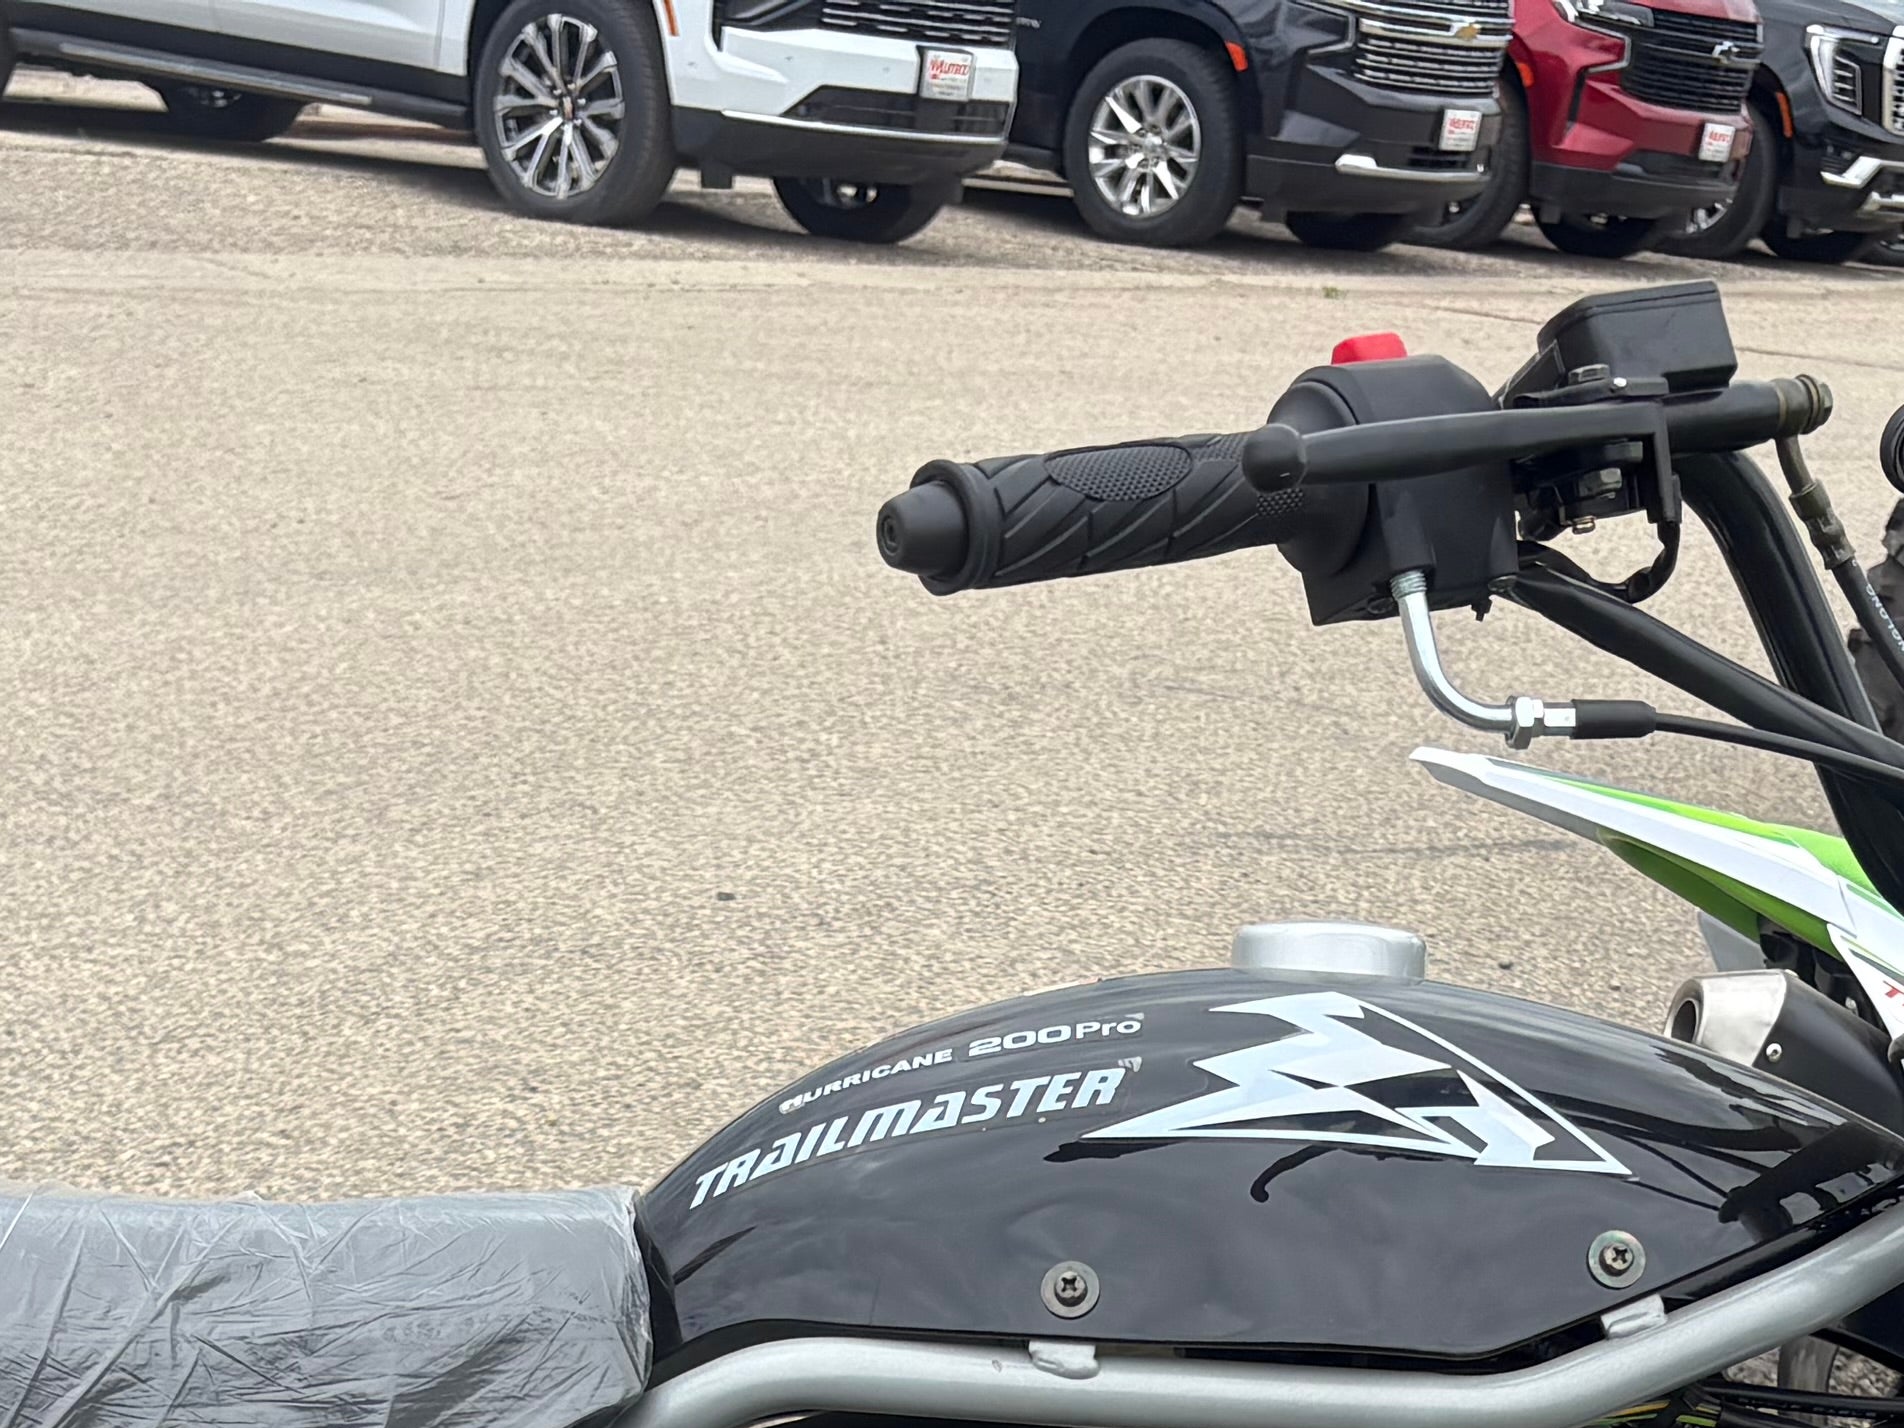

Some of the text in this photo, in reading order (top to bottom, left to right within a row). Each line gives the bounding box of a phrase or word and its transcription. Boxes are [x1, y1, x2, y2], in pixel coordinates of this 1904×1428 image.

[779, 1020, 1141, 1115] HURRICANE 200Pro
[689, 1066, 1126, 1209] TRAILMASTER
